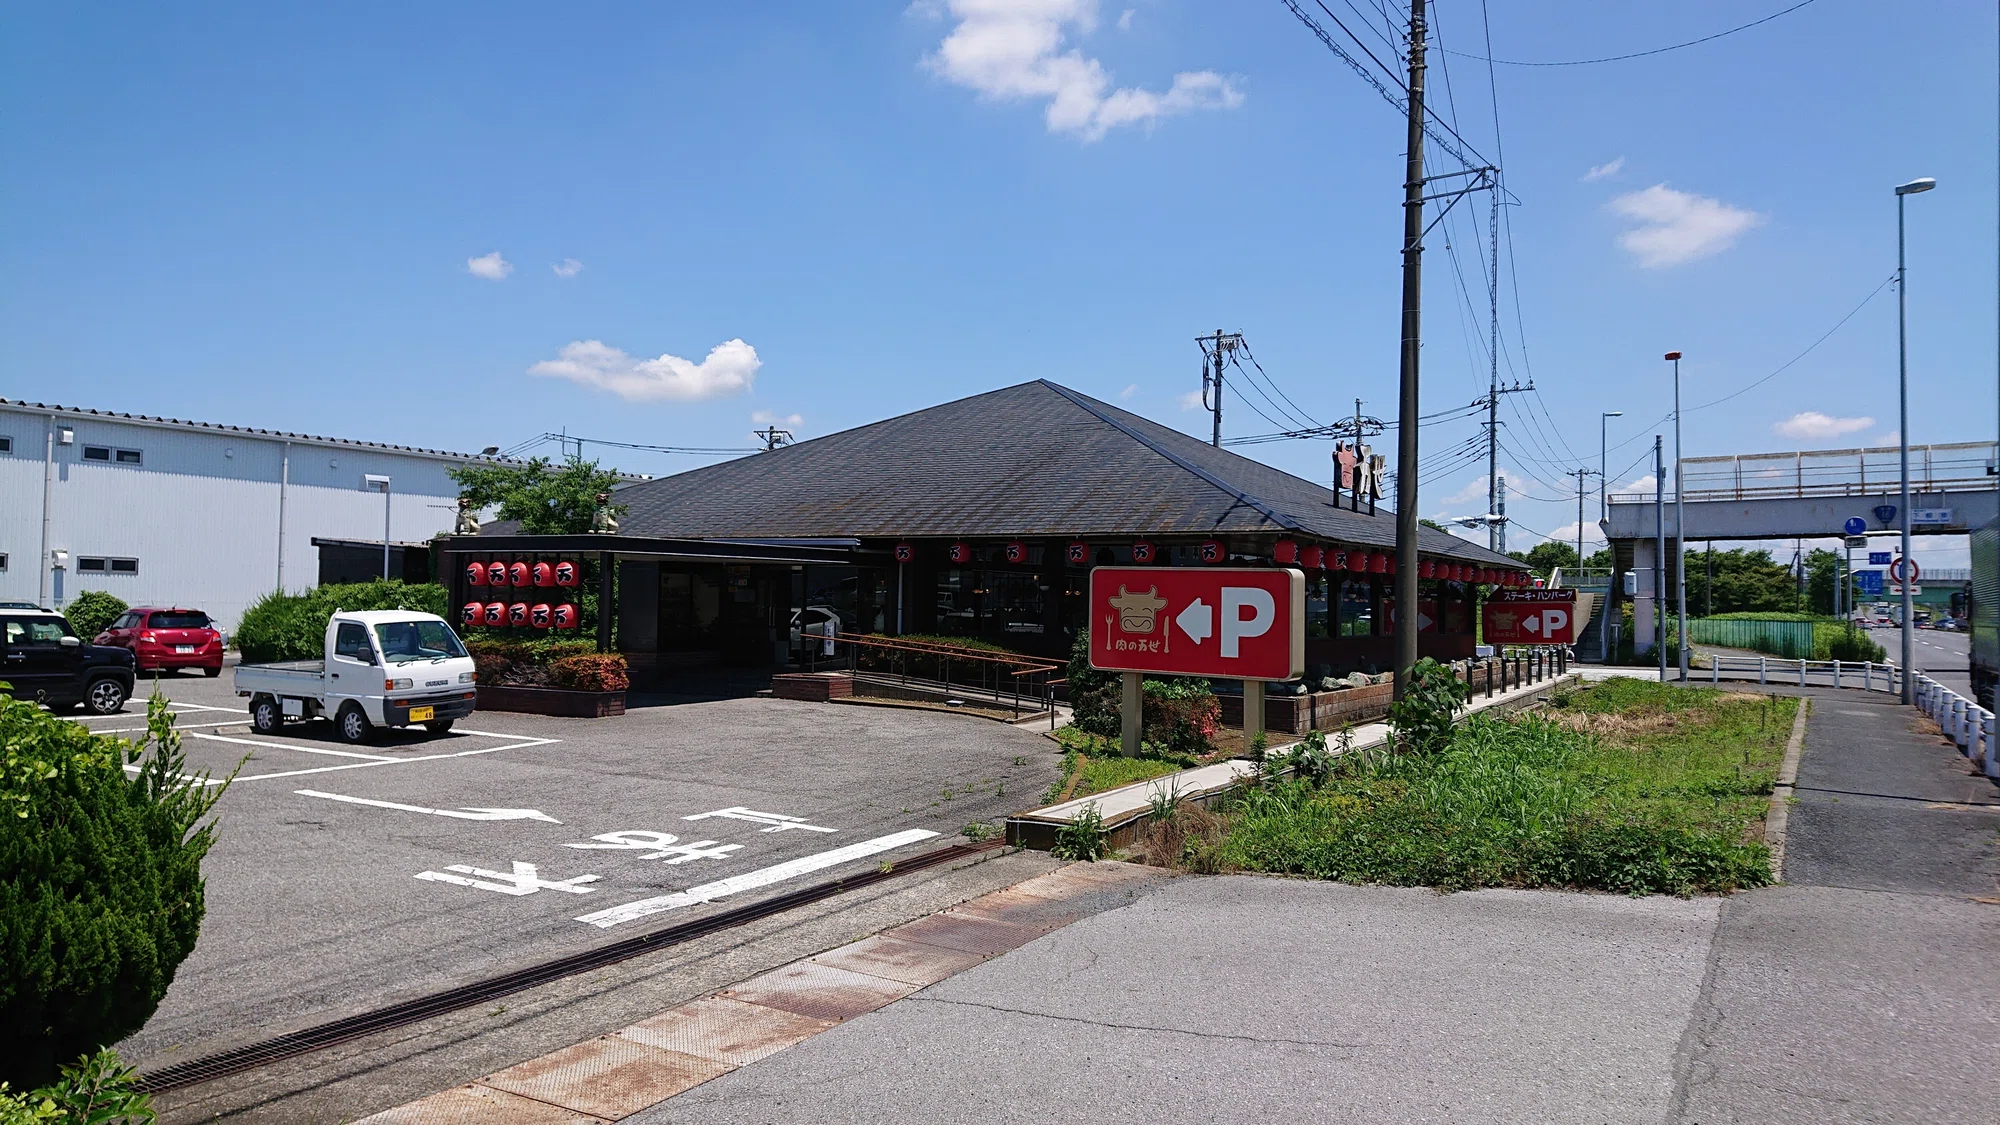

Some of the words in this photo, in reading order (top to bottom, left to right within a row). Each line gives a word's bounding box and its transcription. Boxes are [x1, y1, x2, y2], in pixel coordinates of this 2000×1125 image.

[1504, 590, 1574, 601] ステーキ・ハンバーグ
[1221, 587, 1276, 658] P
[1542, 609, 1568, 639] P
[1115, 639, 1161, 653] 肉の万世
